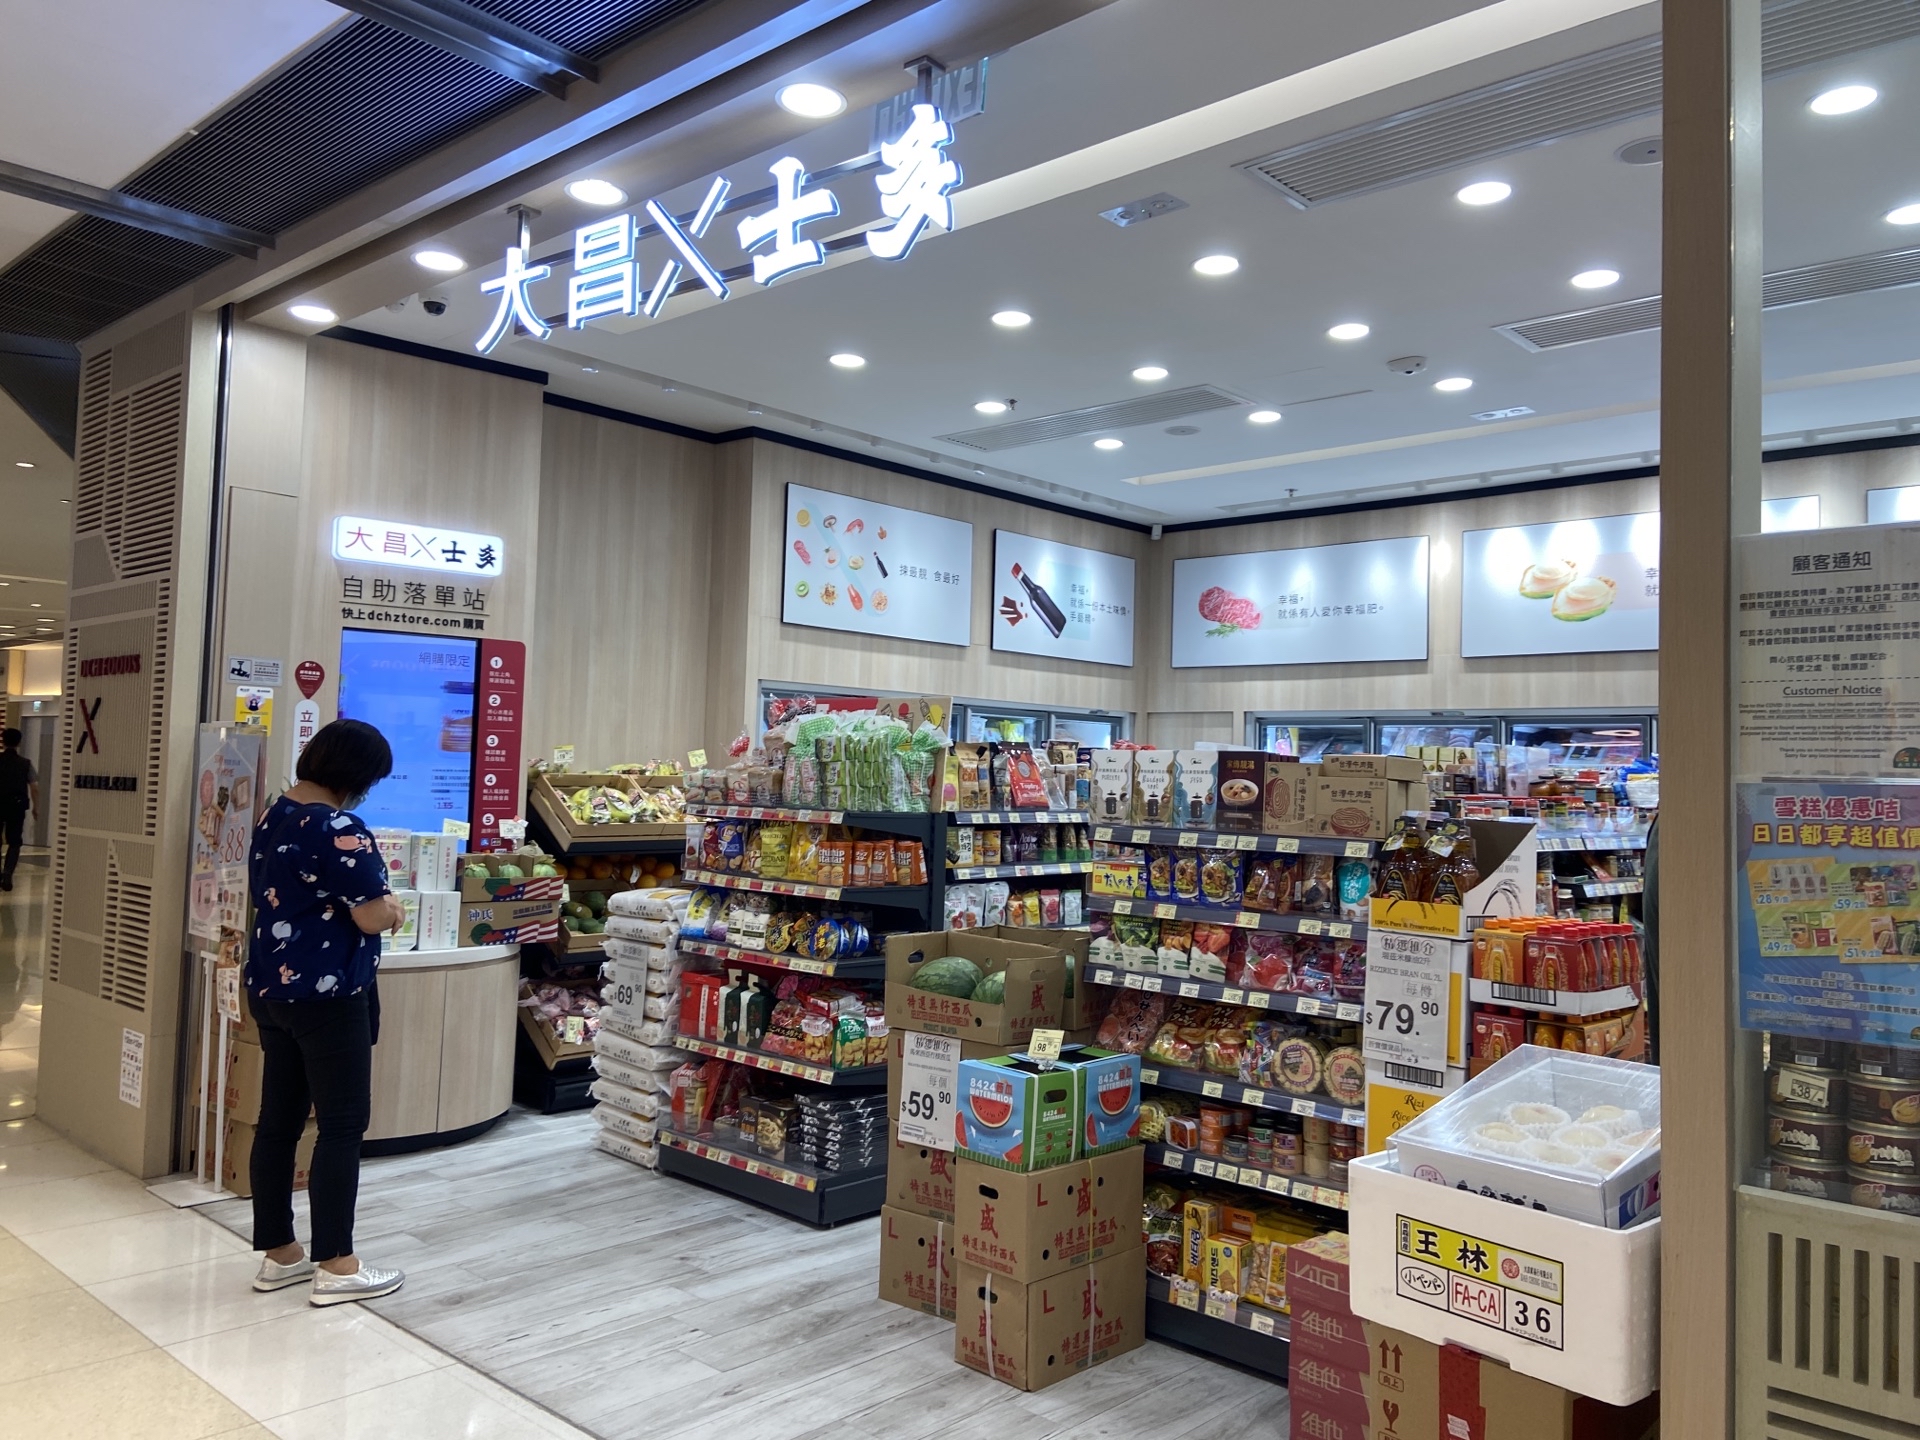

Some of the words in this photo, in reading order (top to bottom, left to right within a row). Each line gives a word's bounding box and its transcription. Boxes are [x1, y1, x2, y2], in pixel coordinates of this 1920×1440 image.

[1792, 551, 1871, 573] 顧客通知
[342, 575, 486, 612] 自助落單站
[419, 651, 470, 667] 網購限定
[1783, 686, 1840, 696] Customer
[1842, 685, 1882, 695] Notice
[1774, 796, 1901, 821] 雪糕優惠咭
[1753, 823, 1920, 849] 日日都享超值價
[1103, 872, 1135, 890] だしの素
[1390, 920, 1402, 928] Pure
[1409, 922, 1441, 932] Preservative
[1383, 936, 1435, 956] 精選推介
[1036, 1042, 1047, 1052] 98
[1404, 1093, 1425, 1111] Rizi
[1037, 1183, 1048, 1207] L
[889, 1217, 899, 1239] L
[1415, 1229, 1489, 1273] 王林
[1043, 1290, 1055, 1314] L
[1455, 1282, 1497, 1316] FA-CA
[1514, 1300, 1551, 1333] 36
[1383, 1374, 1399, 1389] 向上
